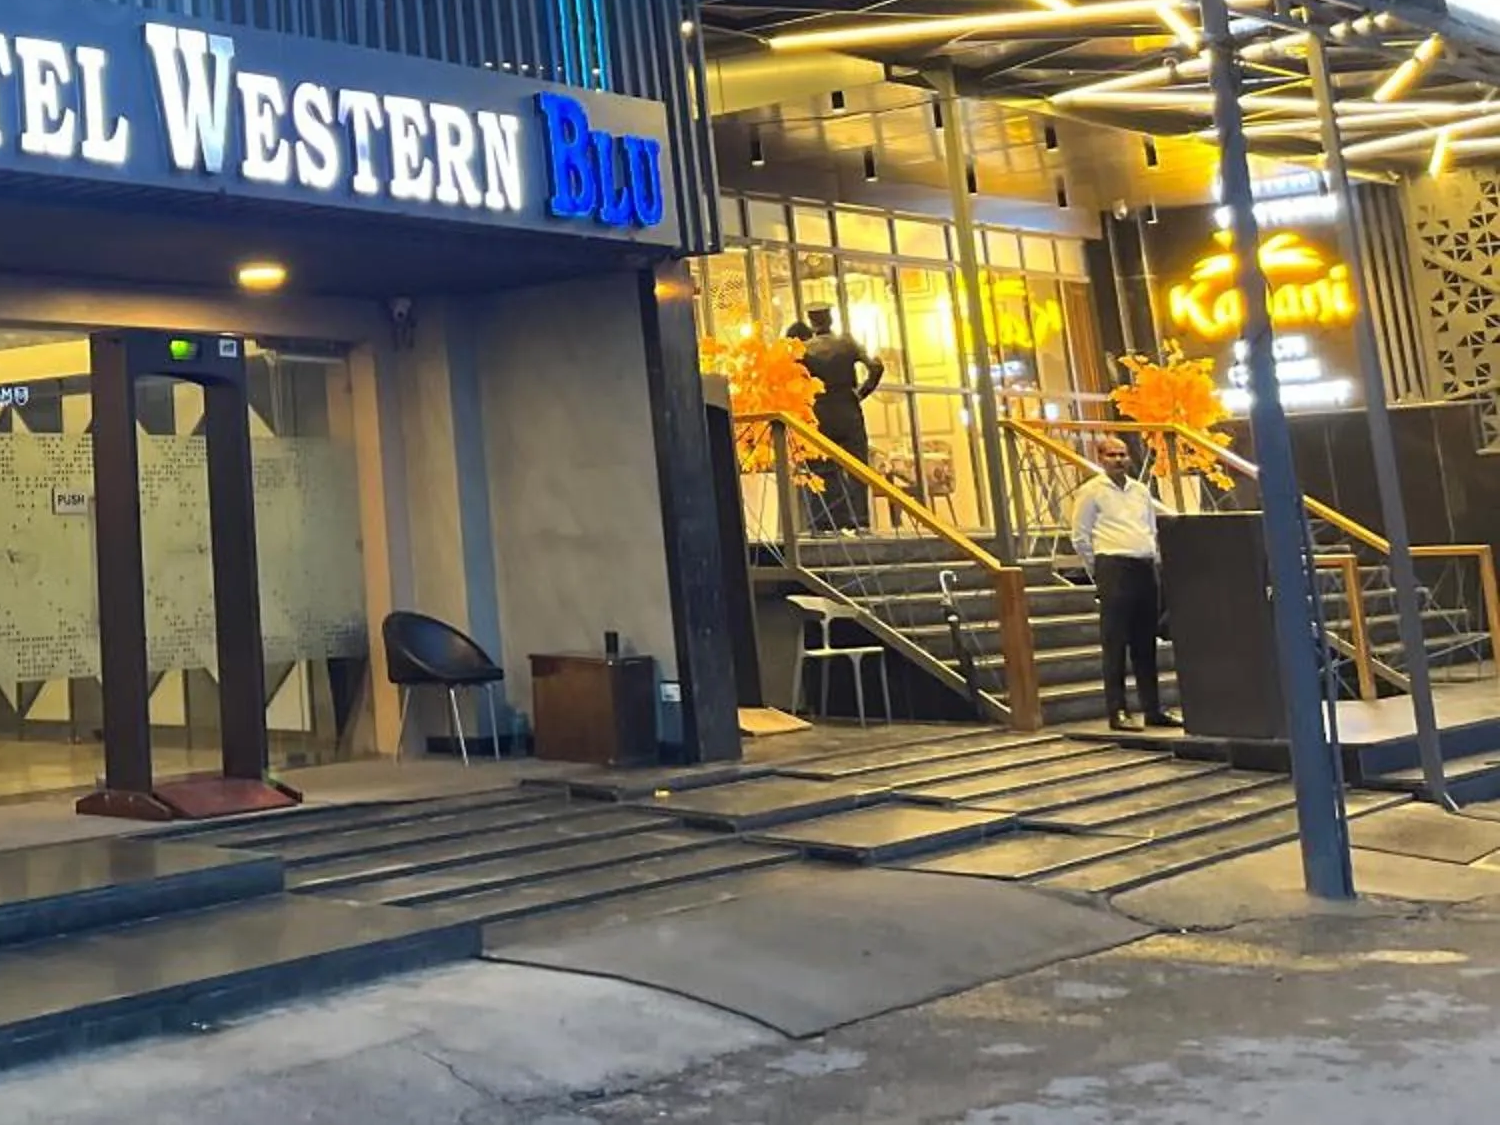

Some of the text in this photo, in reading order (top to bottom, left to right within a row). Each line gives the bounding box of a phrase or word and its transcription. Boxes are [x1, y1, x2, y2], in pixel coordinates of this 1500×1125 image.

[143, 22, 523, 212] WESTERN
[533, 91, 664, 228] BLU
[1168, 263, 1357, 338] Kaani
[57, 494, 85, 507] PUSH
